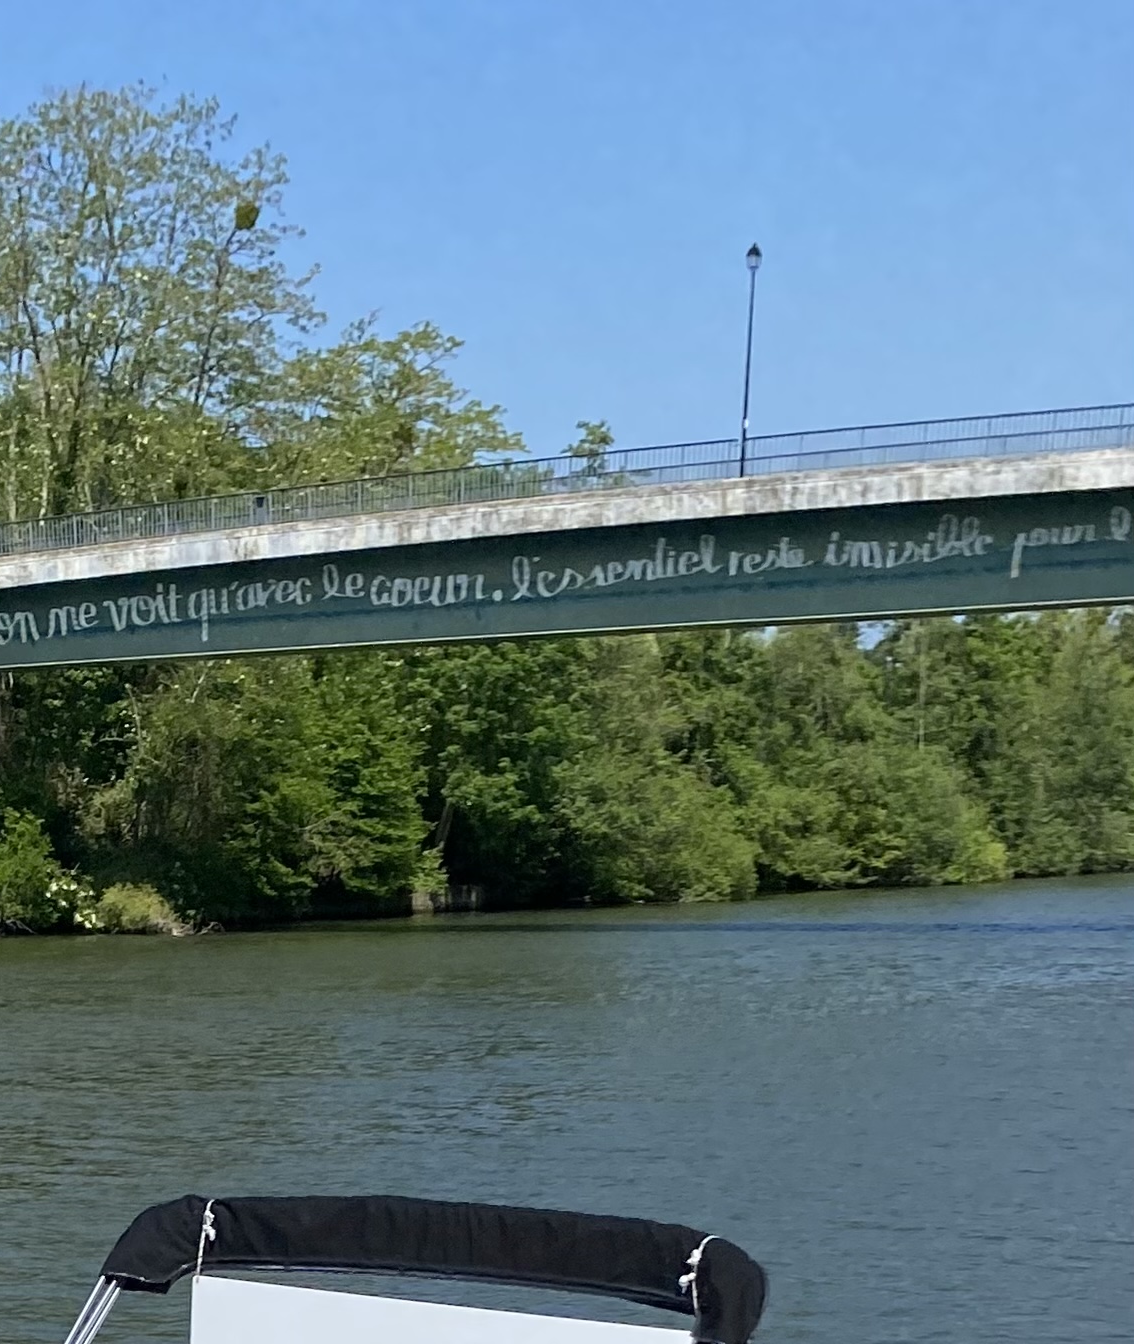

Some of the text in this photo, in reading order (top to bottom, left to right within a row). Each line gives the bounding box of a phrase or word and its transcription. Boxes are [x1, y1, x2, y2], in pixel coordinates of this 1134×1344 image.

[46, 602, 99, 639] ne
[102, 583, 183, 632] voit
[187, 578, 313, 643] qu'avec
[321, 563, 365, 601] le
[510, 534, 723, 602] l'essentiel
[728, 536, 815, 577] reste
[823, 513, 994, 569] invisible
[1010, 524, 1097, 578] pour
